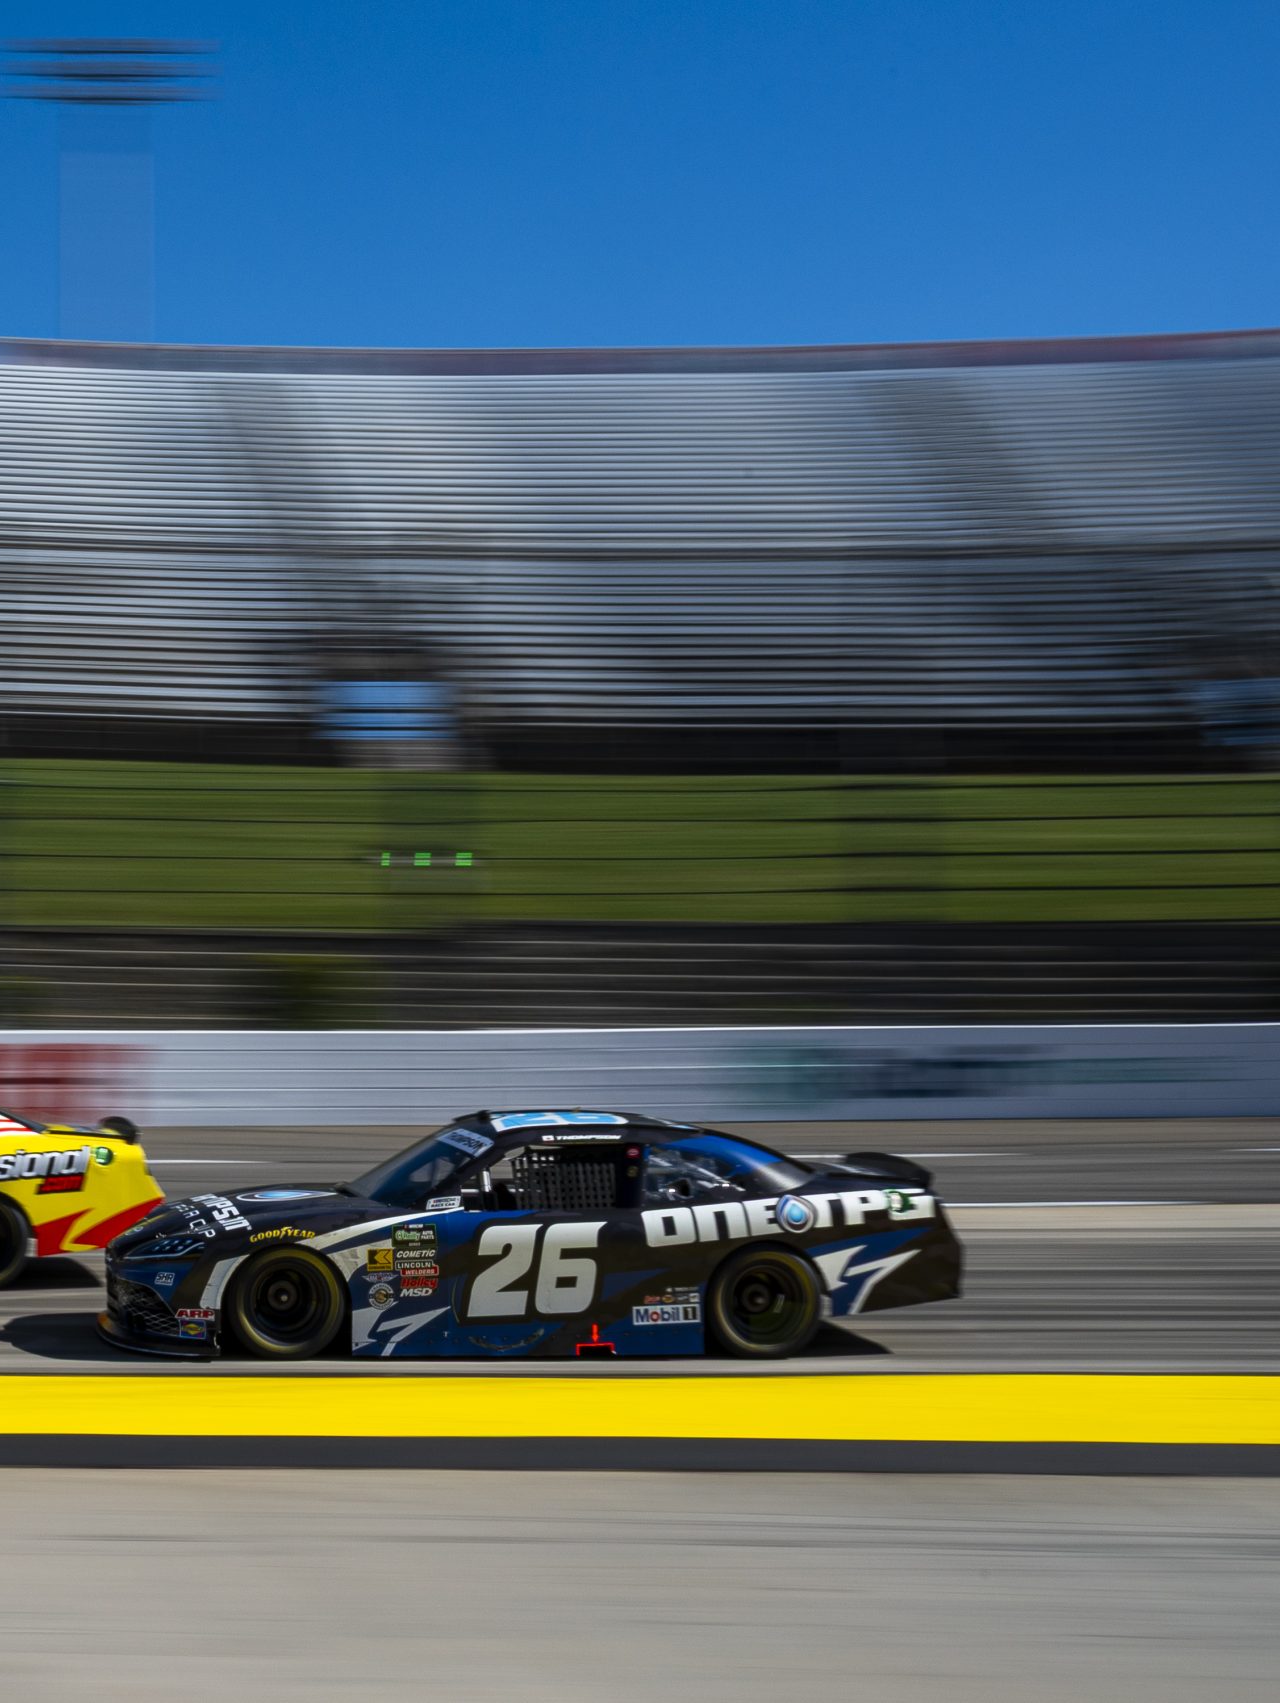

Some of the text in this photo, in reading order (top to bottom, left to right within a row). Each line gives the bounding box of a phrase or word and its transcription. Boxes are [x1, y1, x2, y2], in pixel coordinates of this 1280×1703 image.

[249, 1226, 316, 1243] GOODYEAR
[396, 1249, 436, 1258] COMETIC
[467, 1221, 608, 1317] 26
[401, 1276, 438, 1289] Holley
[400, 1287, 433, 1297] MSD
[177, 1310, 214, 1318] ARP
[635, 1307, 680, 1322] Mobil
